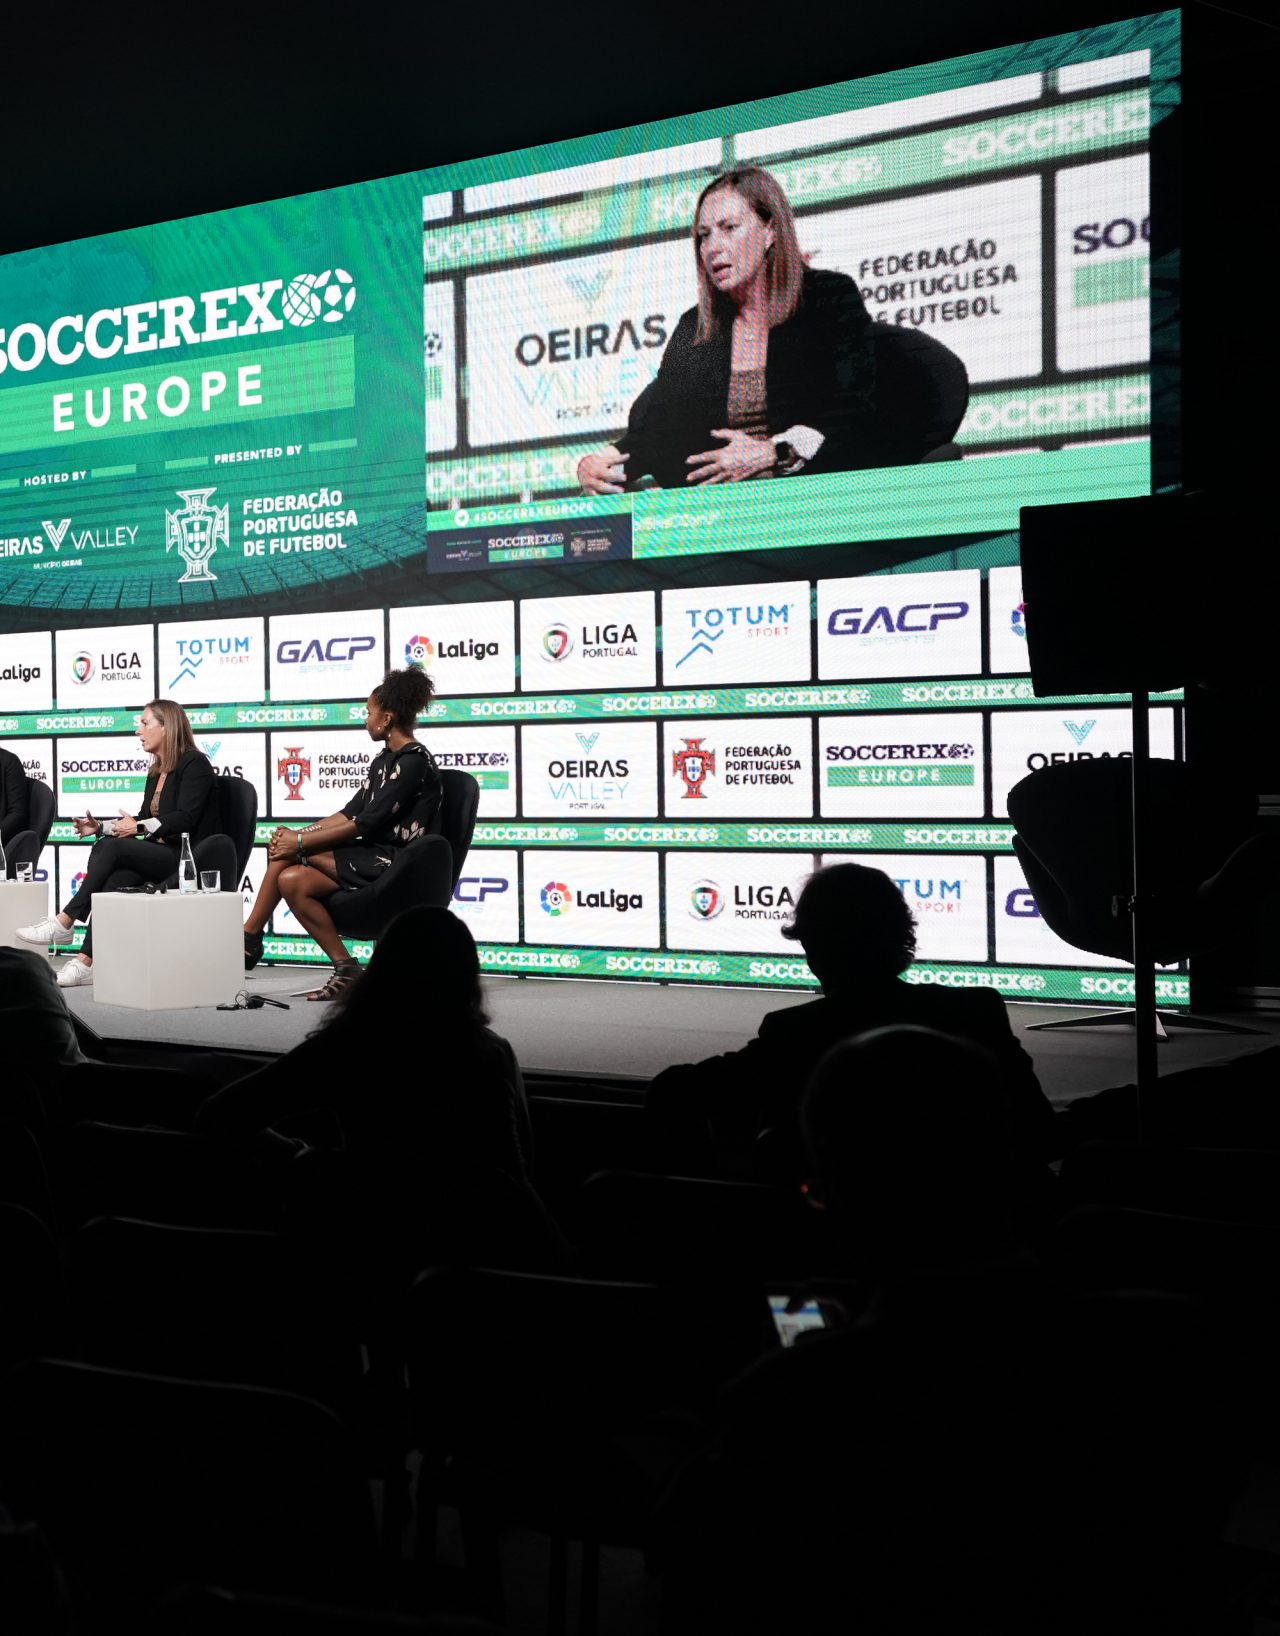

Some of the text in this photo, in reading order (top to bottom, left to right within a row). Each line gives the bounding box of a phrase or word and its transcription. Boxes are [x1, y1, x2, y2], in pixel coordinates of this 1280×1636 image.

[940, 104, 1150, 166] SOCCERE
[859, 239, 997, 279] FEDERAÇÃO
[861, 265, 1018, 302] PORTUGUESA
[896, 297, 1001, 326] FUTEBOL
[515, 315, 667, 367] OEIRAS
[53, 364, 263, 432] EUROPE
[962, 387, 1150, 432] OCCERE
[214, 444, 302, 465] PRESENTED BY
[24, 470, 87, 487] HOSTED BY
[243, 487, 343, 516] FEDERAÇÃO
[243, 509, 358, 536] PORTUGUESA
[70, 525, 139, 550] VALLEY
[243, 532, 348, 557] DE FUTEBOL
[488, 534, 550, 548] SOCCEREX
[685, 604, 789, 629] TOTUM
[827, 601, 970, 636] GACP
[582, 623, 638, 645] LIGA
[747, 626, 789, 639] SPORT
[176, 637, 250, 656] TOTUM
[277, 636, 376, 664] GACP
[438, 638, 499, 661] LaLiga
[582, 646, 638, 658] PORTUGAL
[101, 652, 142, 670] LIGA
[101, 671, 142, 681] PORTUGAL
[745, 689, 847, 708] SOCCEREX
[901, 682, 1016, 703] SOCCEREX
[471, 699, 557, 716] SOCCEREX
[602, 694, 698, 711] SOCCEREX
[36, 714, 100, 730] SOCCEREX
[237, 708, 311, 723] SOCCEREX
[319, 753, 369, 766] FEDERAÇÃO
[434, 753, 489, 767] CEREX
[725, 744, 792, 758] FEDERAÇÃO
[826, 744, 948, 761] SOCCEREX
[61, 760, 134, 773] SOCCEREX
[319, 766, 370, 777] PORTUGUES
[548, 760, 629, 778] OEIRAS
[725, 760, 801, 772] PORTUGUESA
[80, 779, 130, 790] EUROPE
[319, 779, 331, 789] DE
[725, 773, 793, 785] DE FUTEBOL
[858, 769, 941, 784] EUROPE
[548, 782, 629, 800] VALLEY
[473, 828, 558, 840] SOCCEREX
[604, 829, 698, 842] SOCCEREX
[747, 828, 850, 843] SOCCEREX
[734, 885, 795, 906] LIGA
[895, 879, 962, 900] TUM
[577, 888, 643, 912] LaLiga
[262, 941, 315, 955] CCEREX
[606, 956, 700, 973] SOCCEREX
[907, 968, 1022, 991] SOCCEREX
